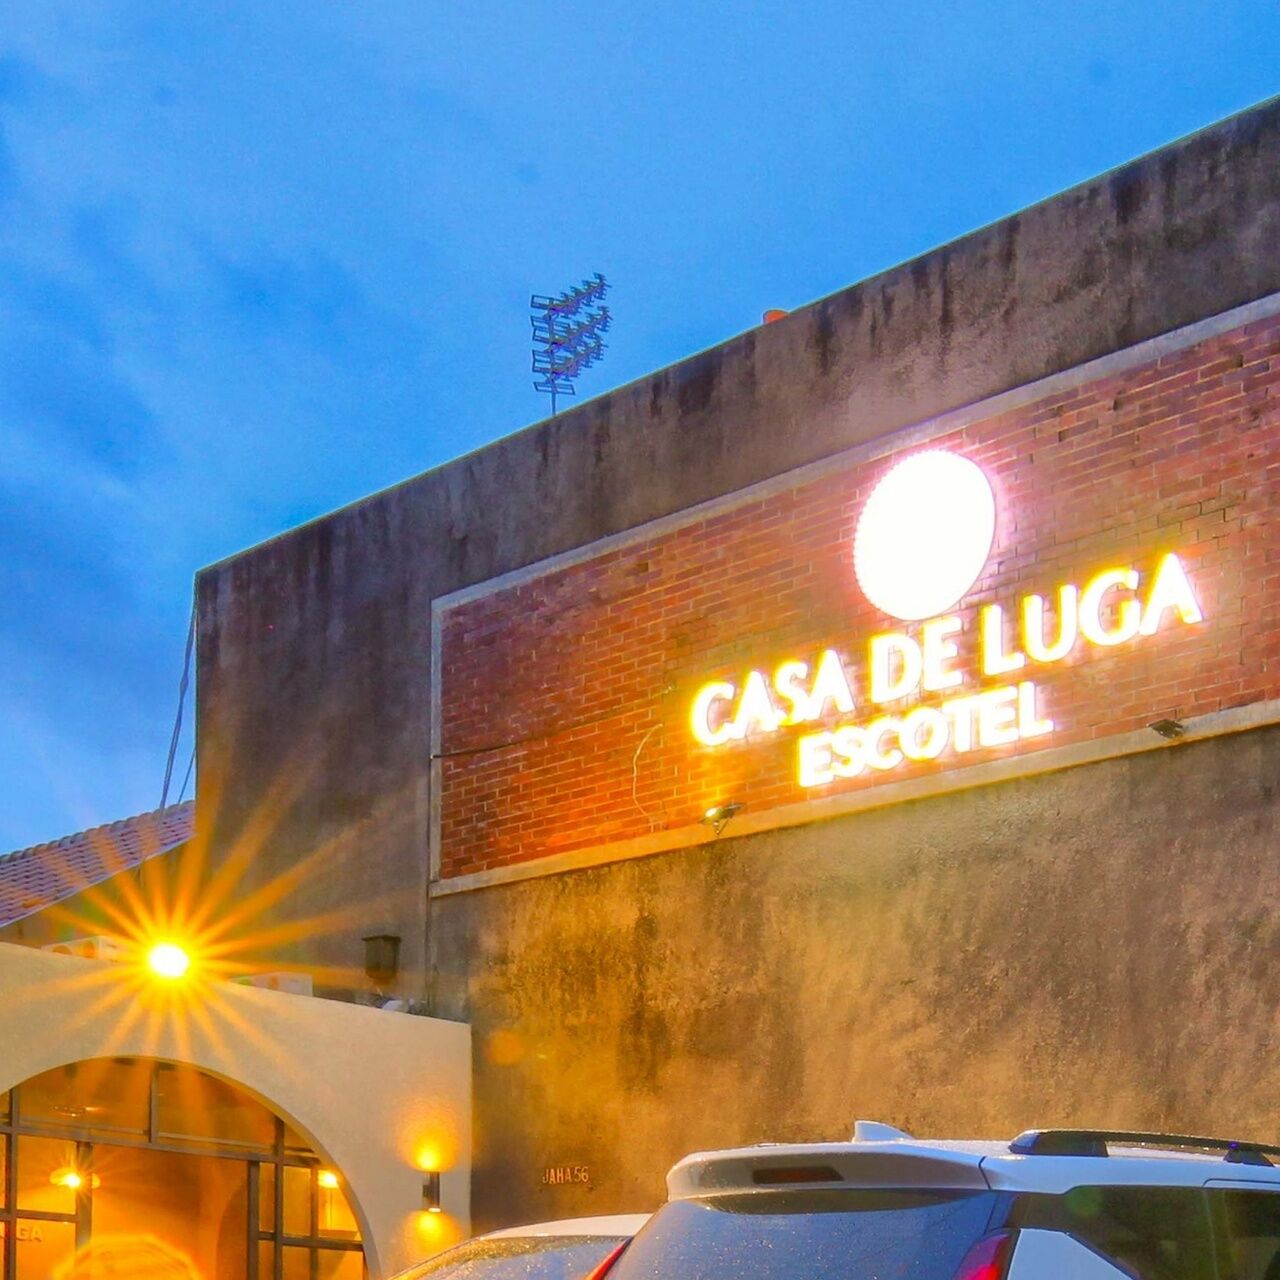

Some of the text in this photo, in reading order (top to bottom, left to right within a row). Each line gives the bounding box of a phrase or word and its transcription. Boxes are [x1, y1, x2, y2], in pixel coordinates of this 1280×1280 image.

[691, 552, 1203, 746] CASA DE LUGA
[799, 681, 1054, 788] ESCOTEL
